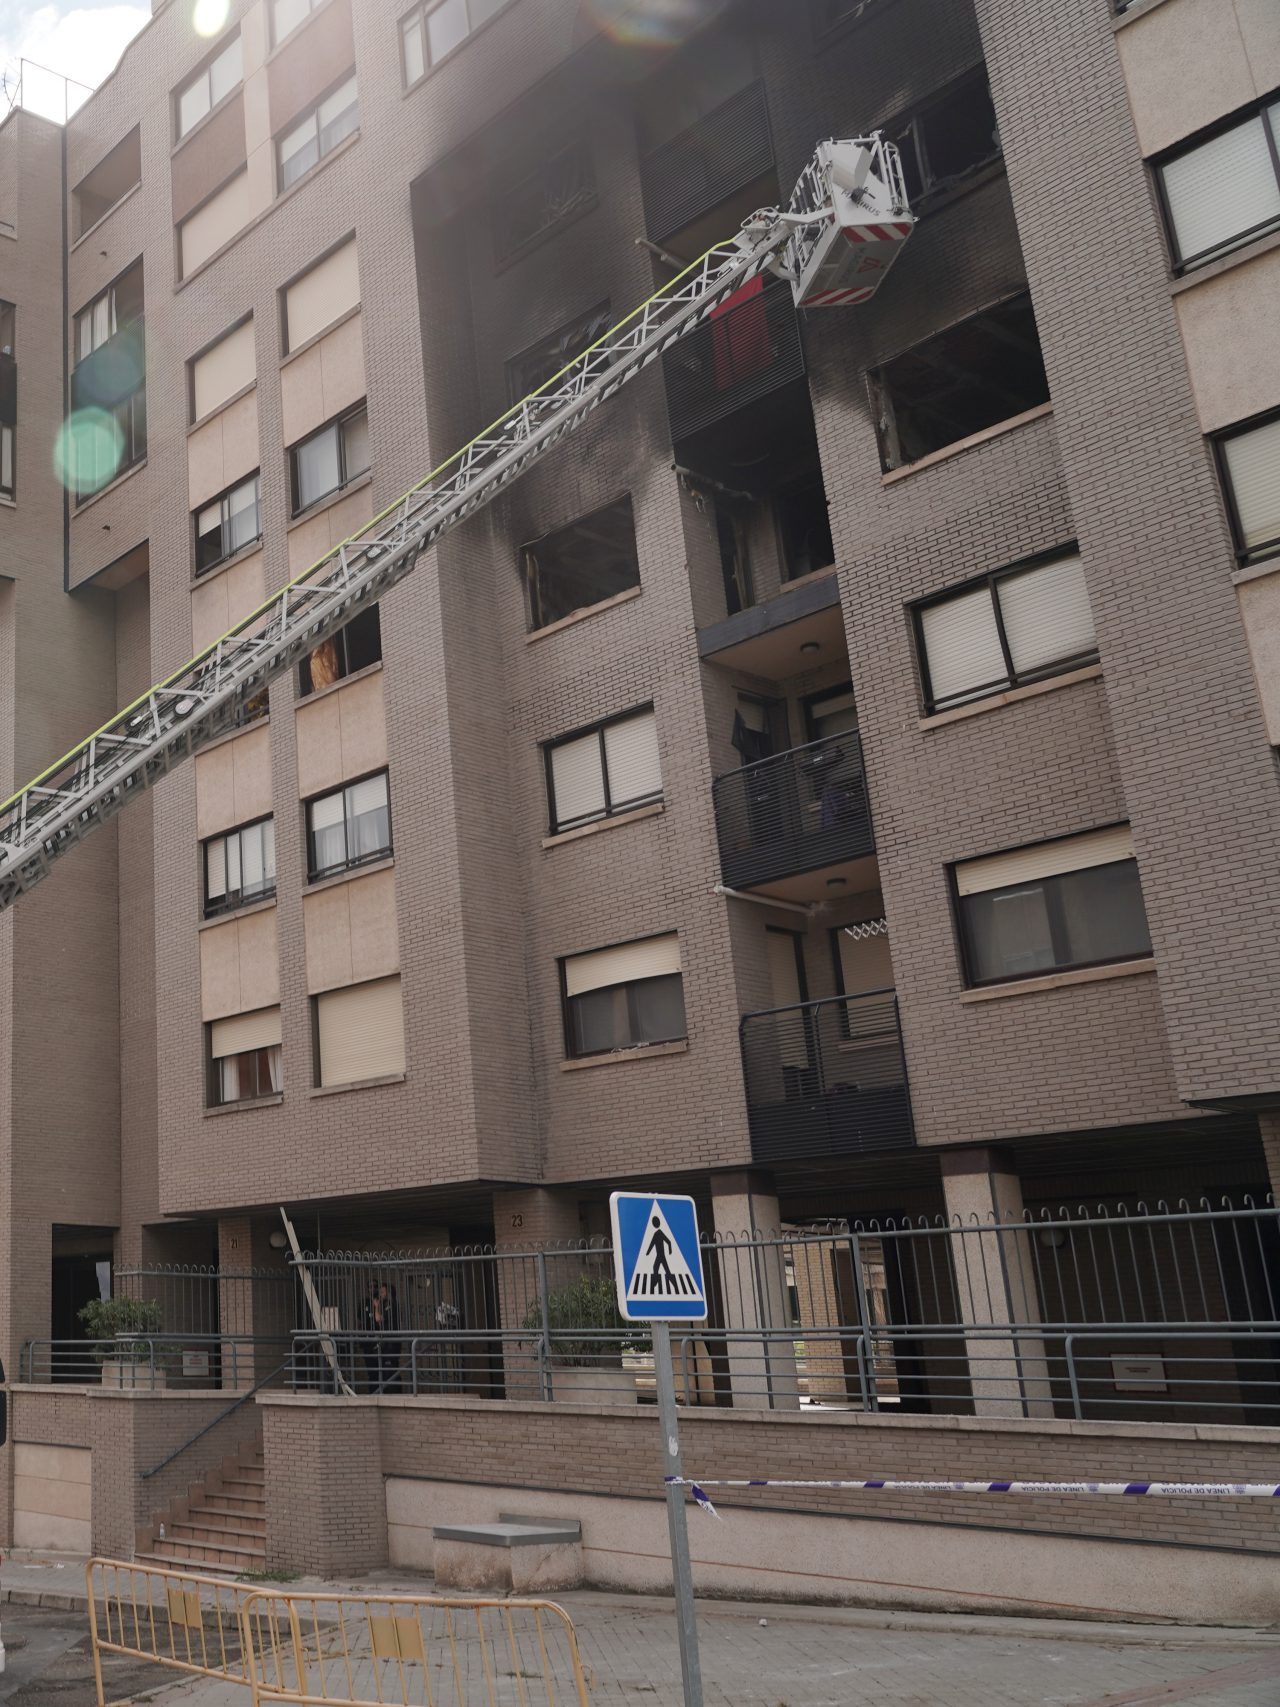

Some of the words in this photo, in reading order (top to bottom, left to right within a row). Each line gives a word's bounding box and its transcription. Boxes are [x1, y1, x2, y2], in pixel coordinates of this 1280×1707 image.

[840, 189, 880, 216] MIRUS
[511, 1214, 523, 1228] 23
[230, 1238, 238, 1249] 21
[1161, 1487, 1193, 1495] POLICIA
[1194, 1487, 1206, 1495] DE
[1208, 1487, 1230, 1495] LINEA
